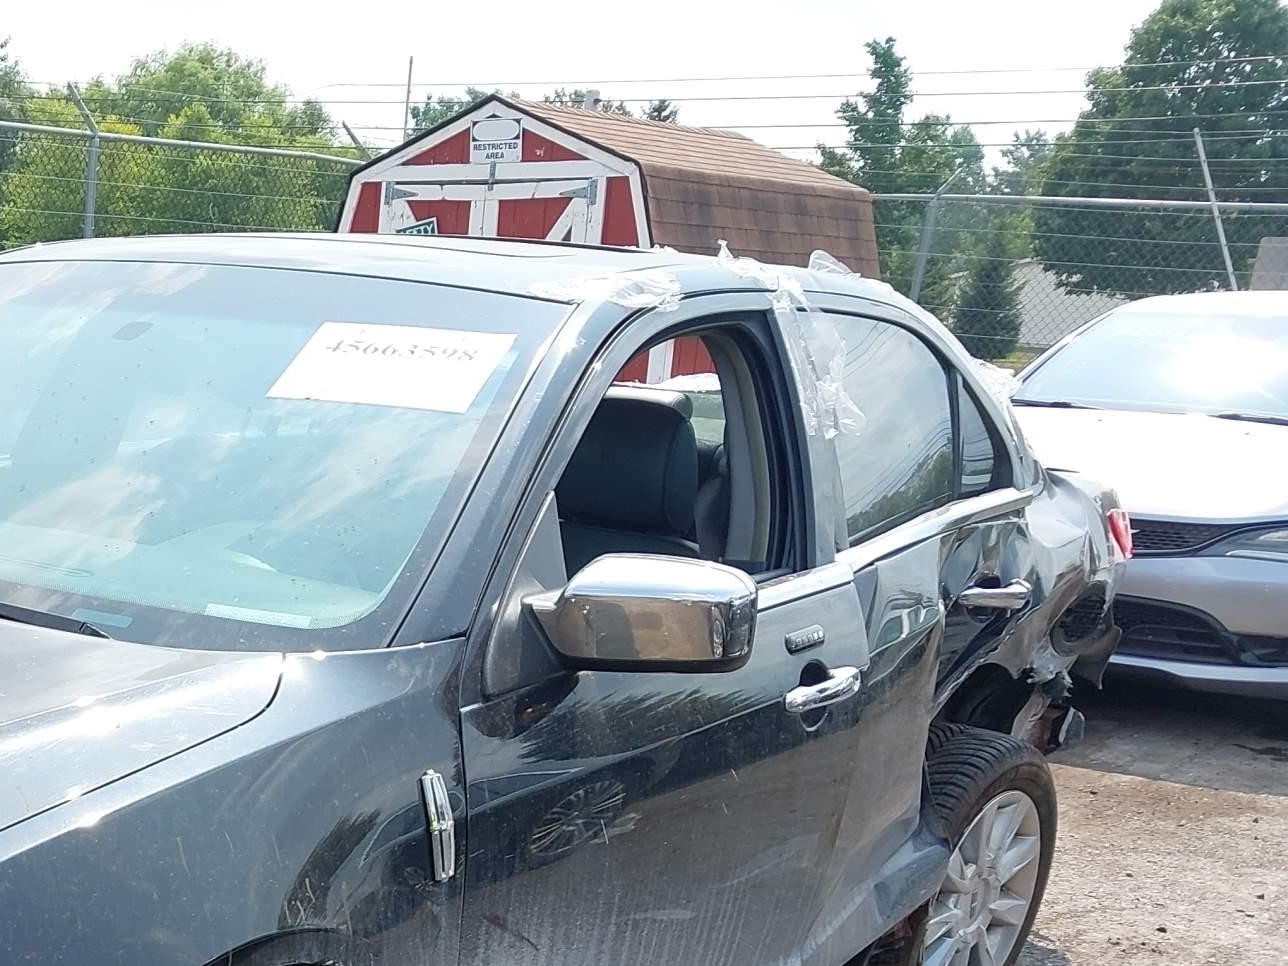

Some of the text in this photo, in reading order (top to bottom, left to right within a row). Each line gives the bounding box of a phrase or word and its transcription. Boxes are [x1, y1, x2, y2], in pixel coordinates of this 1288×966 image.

[473, 142, 518, 151] RESTRICTED
[485, 151, 505, 160] AREA
[324, 338, 479, 361] 45663598
